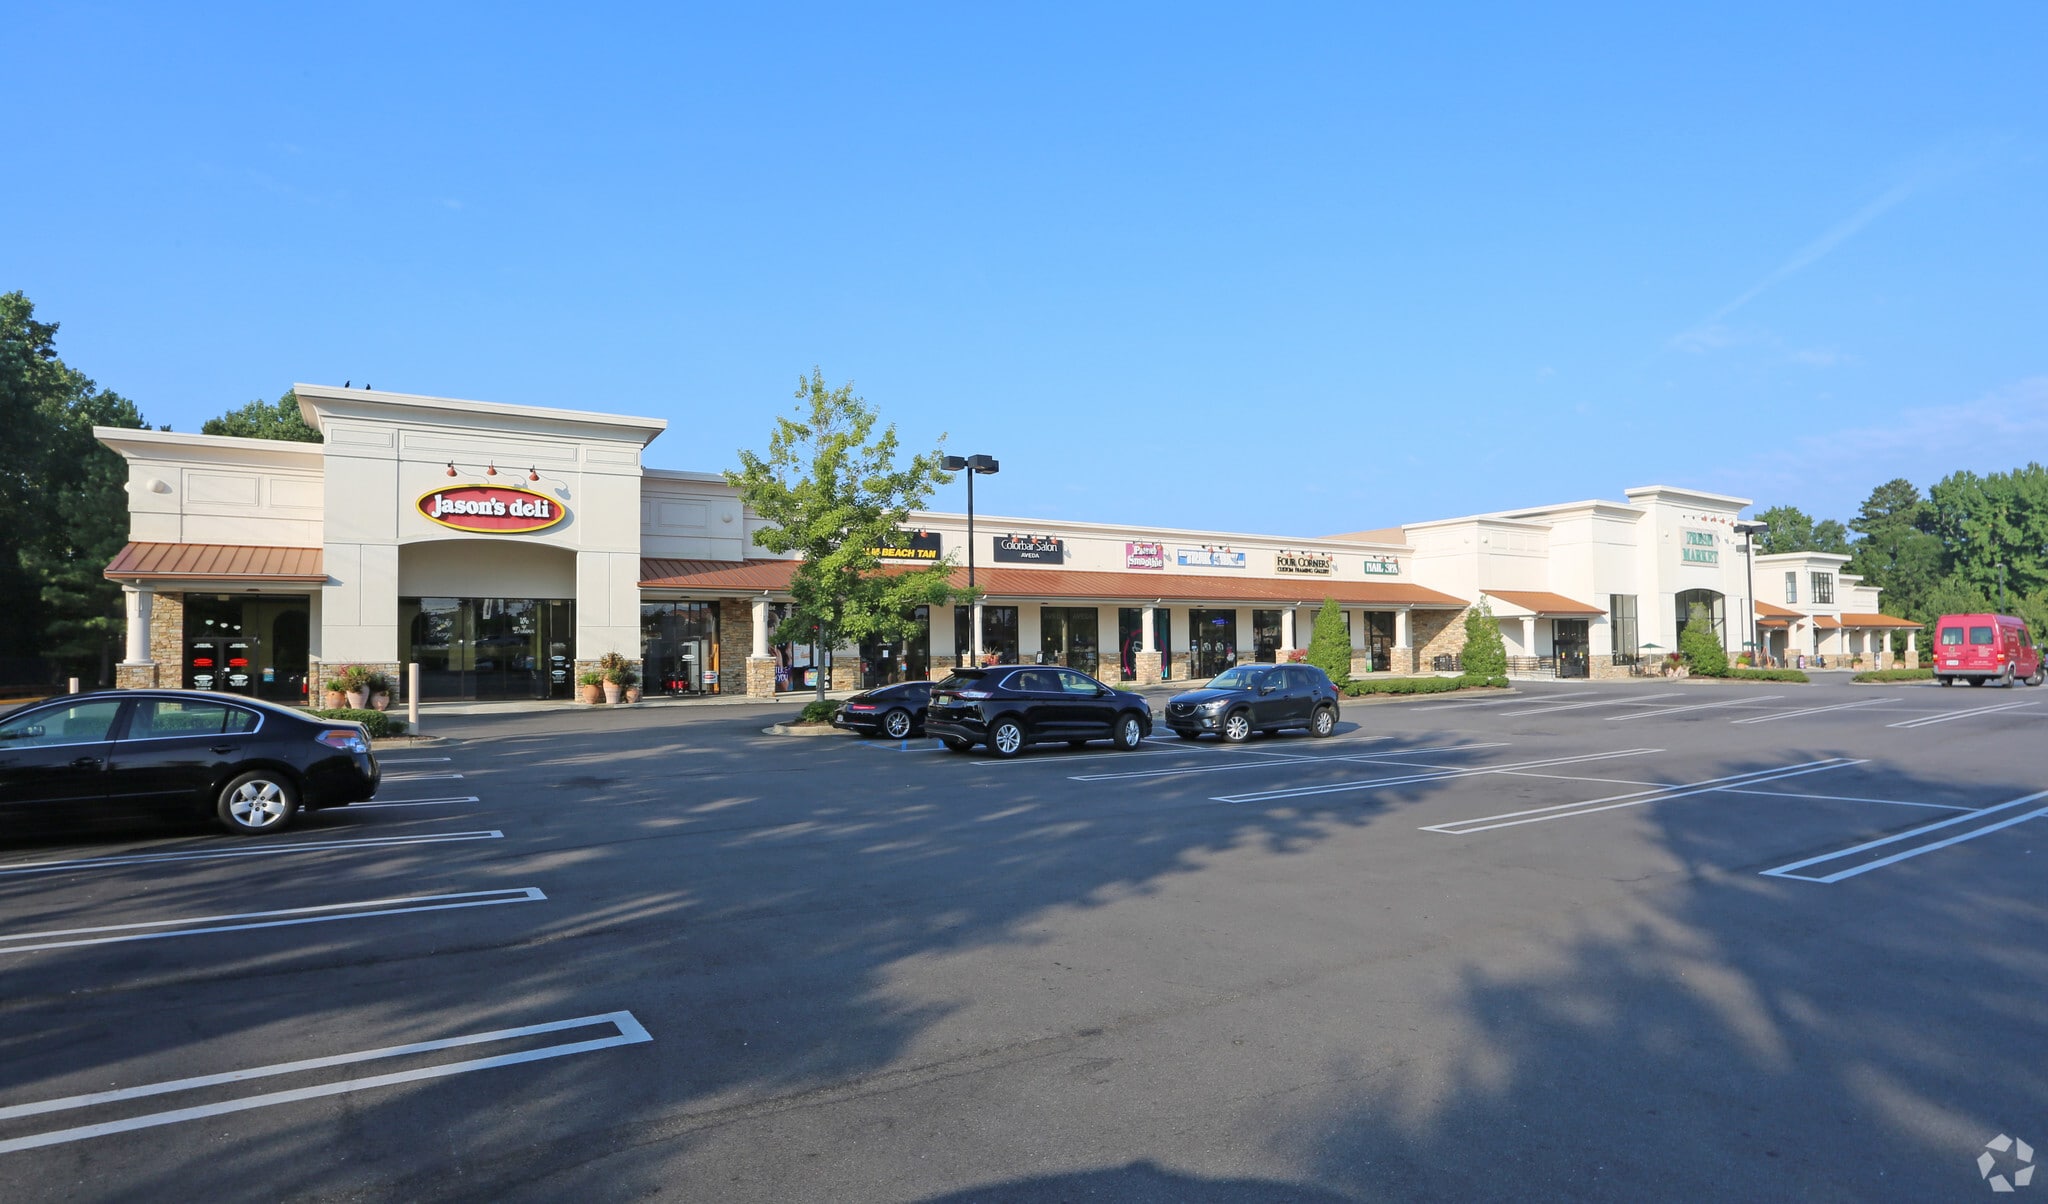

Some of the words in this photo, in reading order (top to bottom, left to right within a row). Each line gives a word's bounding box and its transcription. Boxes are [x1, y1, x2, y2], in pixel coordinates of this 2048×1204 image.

[432, 494, 505, 518] Jason's
[510, 498, 549, 518] deli
[1001, 539, 1034, 551] Colorbar
[1036, 541, 1057, 552] Salon
[882, 548, 915, 557] BEACH
[917, 549, 936, 558] TAN
[1683, 548, 1718, 563] MARKET
[1277, 556, 1296, 566] FOUR
[1298, 558, 1329, 568] CORNERS
[1366, 562, 1384, 573] NAIL
[1385, 563, 1398, 574] SPA
